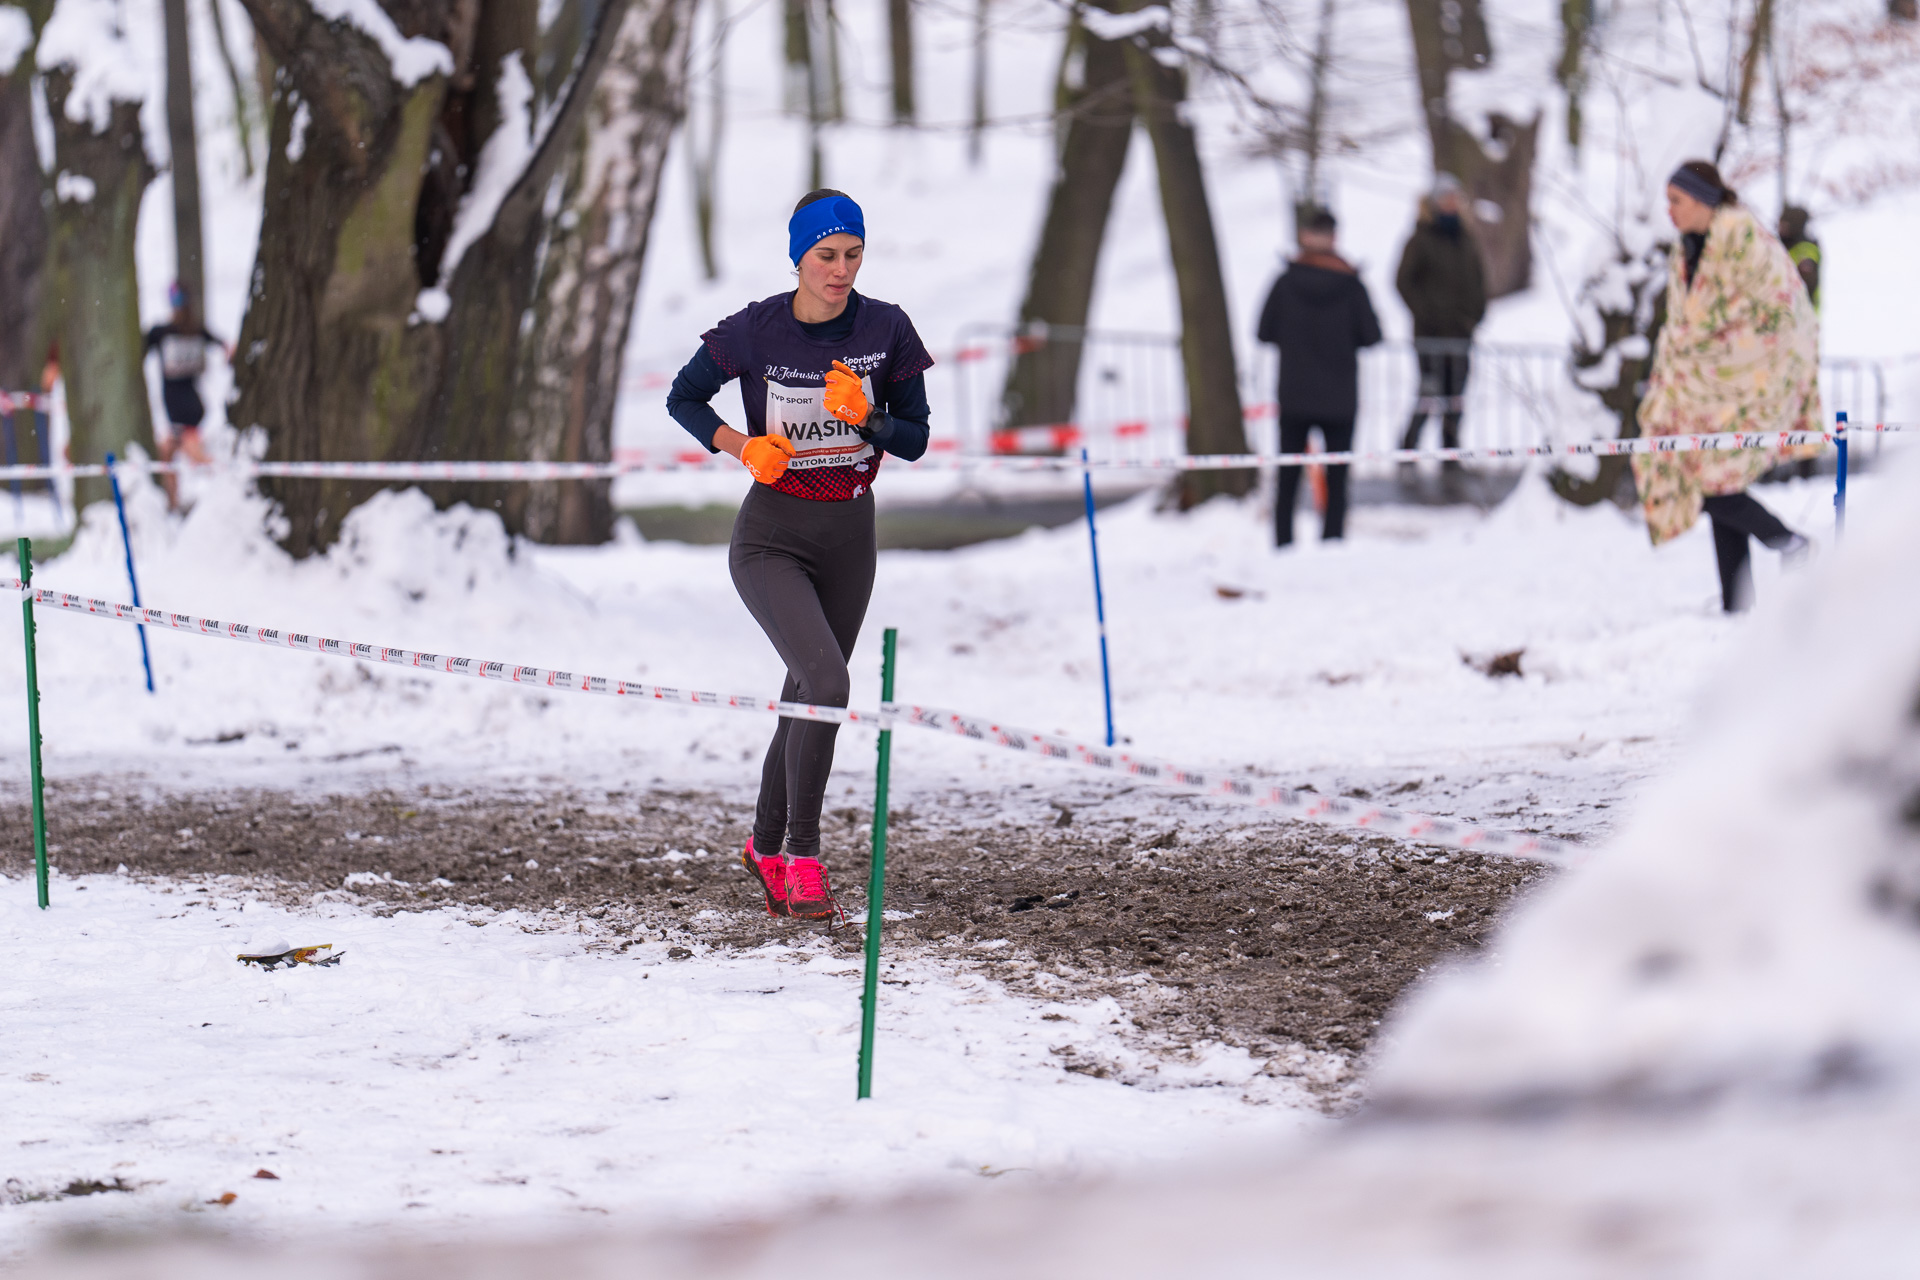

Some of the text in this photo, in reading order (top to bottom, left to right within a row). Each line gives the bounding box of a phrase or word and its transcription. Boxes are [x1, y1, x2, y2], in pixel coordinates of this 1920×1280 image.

[770, 392, 813, 405] TVP SPORT
[791, 456, 853, 468] BYTOM 2024
